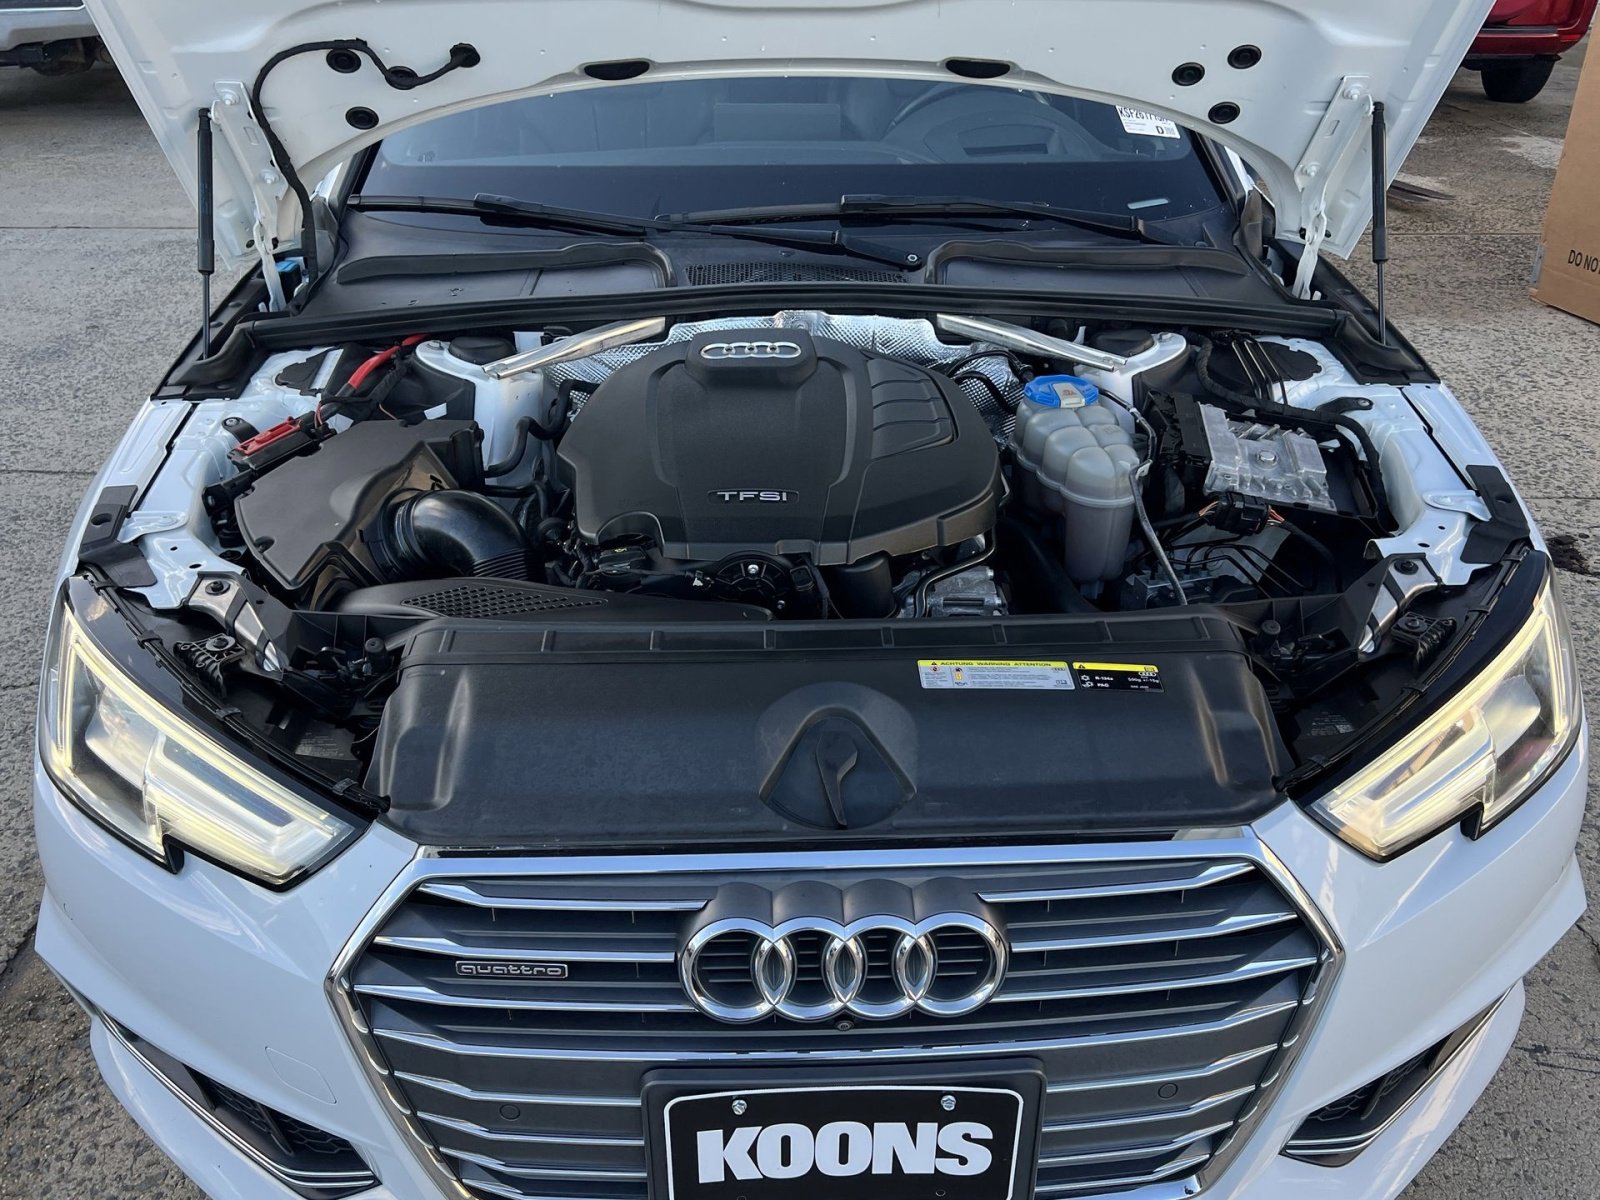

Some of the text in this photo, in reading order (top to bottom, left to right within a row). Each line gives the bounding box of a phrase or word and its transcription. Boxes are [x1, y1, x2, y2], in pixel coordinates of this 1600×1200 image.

[1568, 249, 1600, 275] DO NO
[717, 491, 787, 501] TFSI
[461, 965, 562, 976] quattro
[696, 1121, 994, 1184] KOONS
